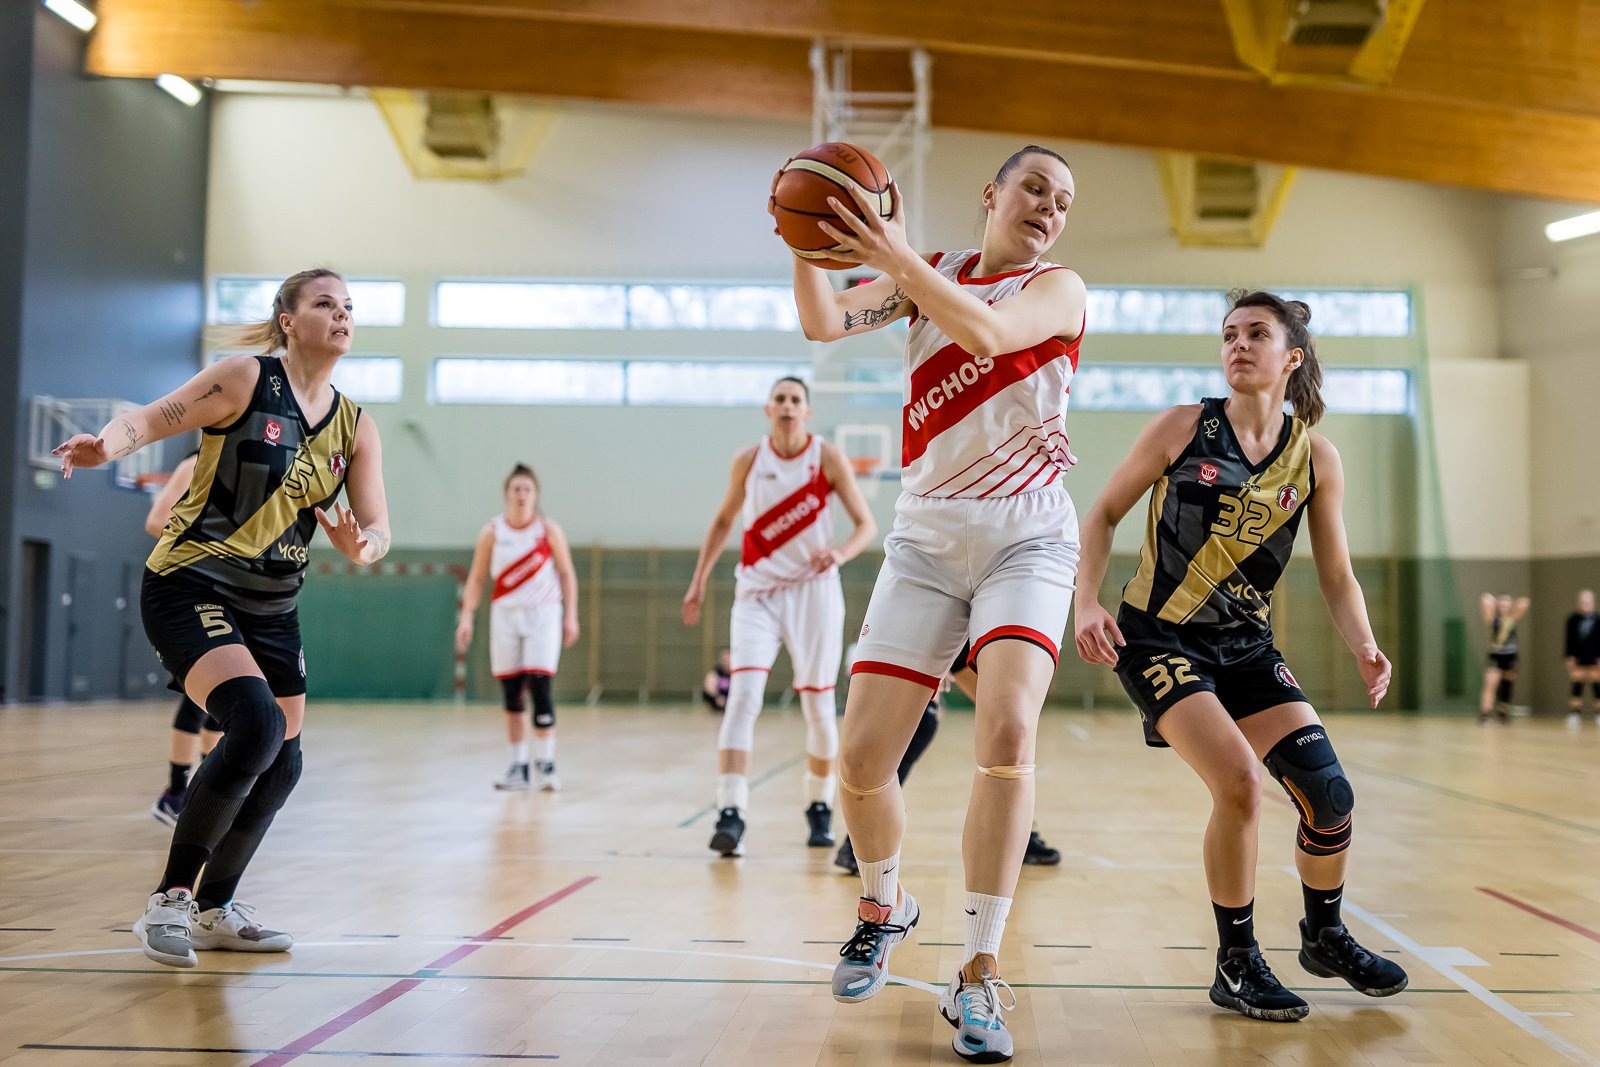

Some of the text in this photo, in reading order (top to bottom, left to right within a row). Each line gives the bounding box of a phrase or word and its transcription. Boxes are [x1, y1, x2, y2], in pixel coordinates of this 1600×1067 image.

[908, 355, 995, 431] WICHOS
[283, 457, 316, 499] 5
[760, 492, 821, 541] WICHOS
[1209, 493, 1272, 546] 32
[200, 611, 233, 638] 5
[1142, 656, 1201, 700] 32
